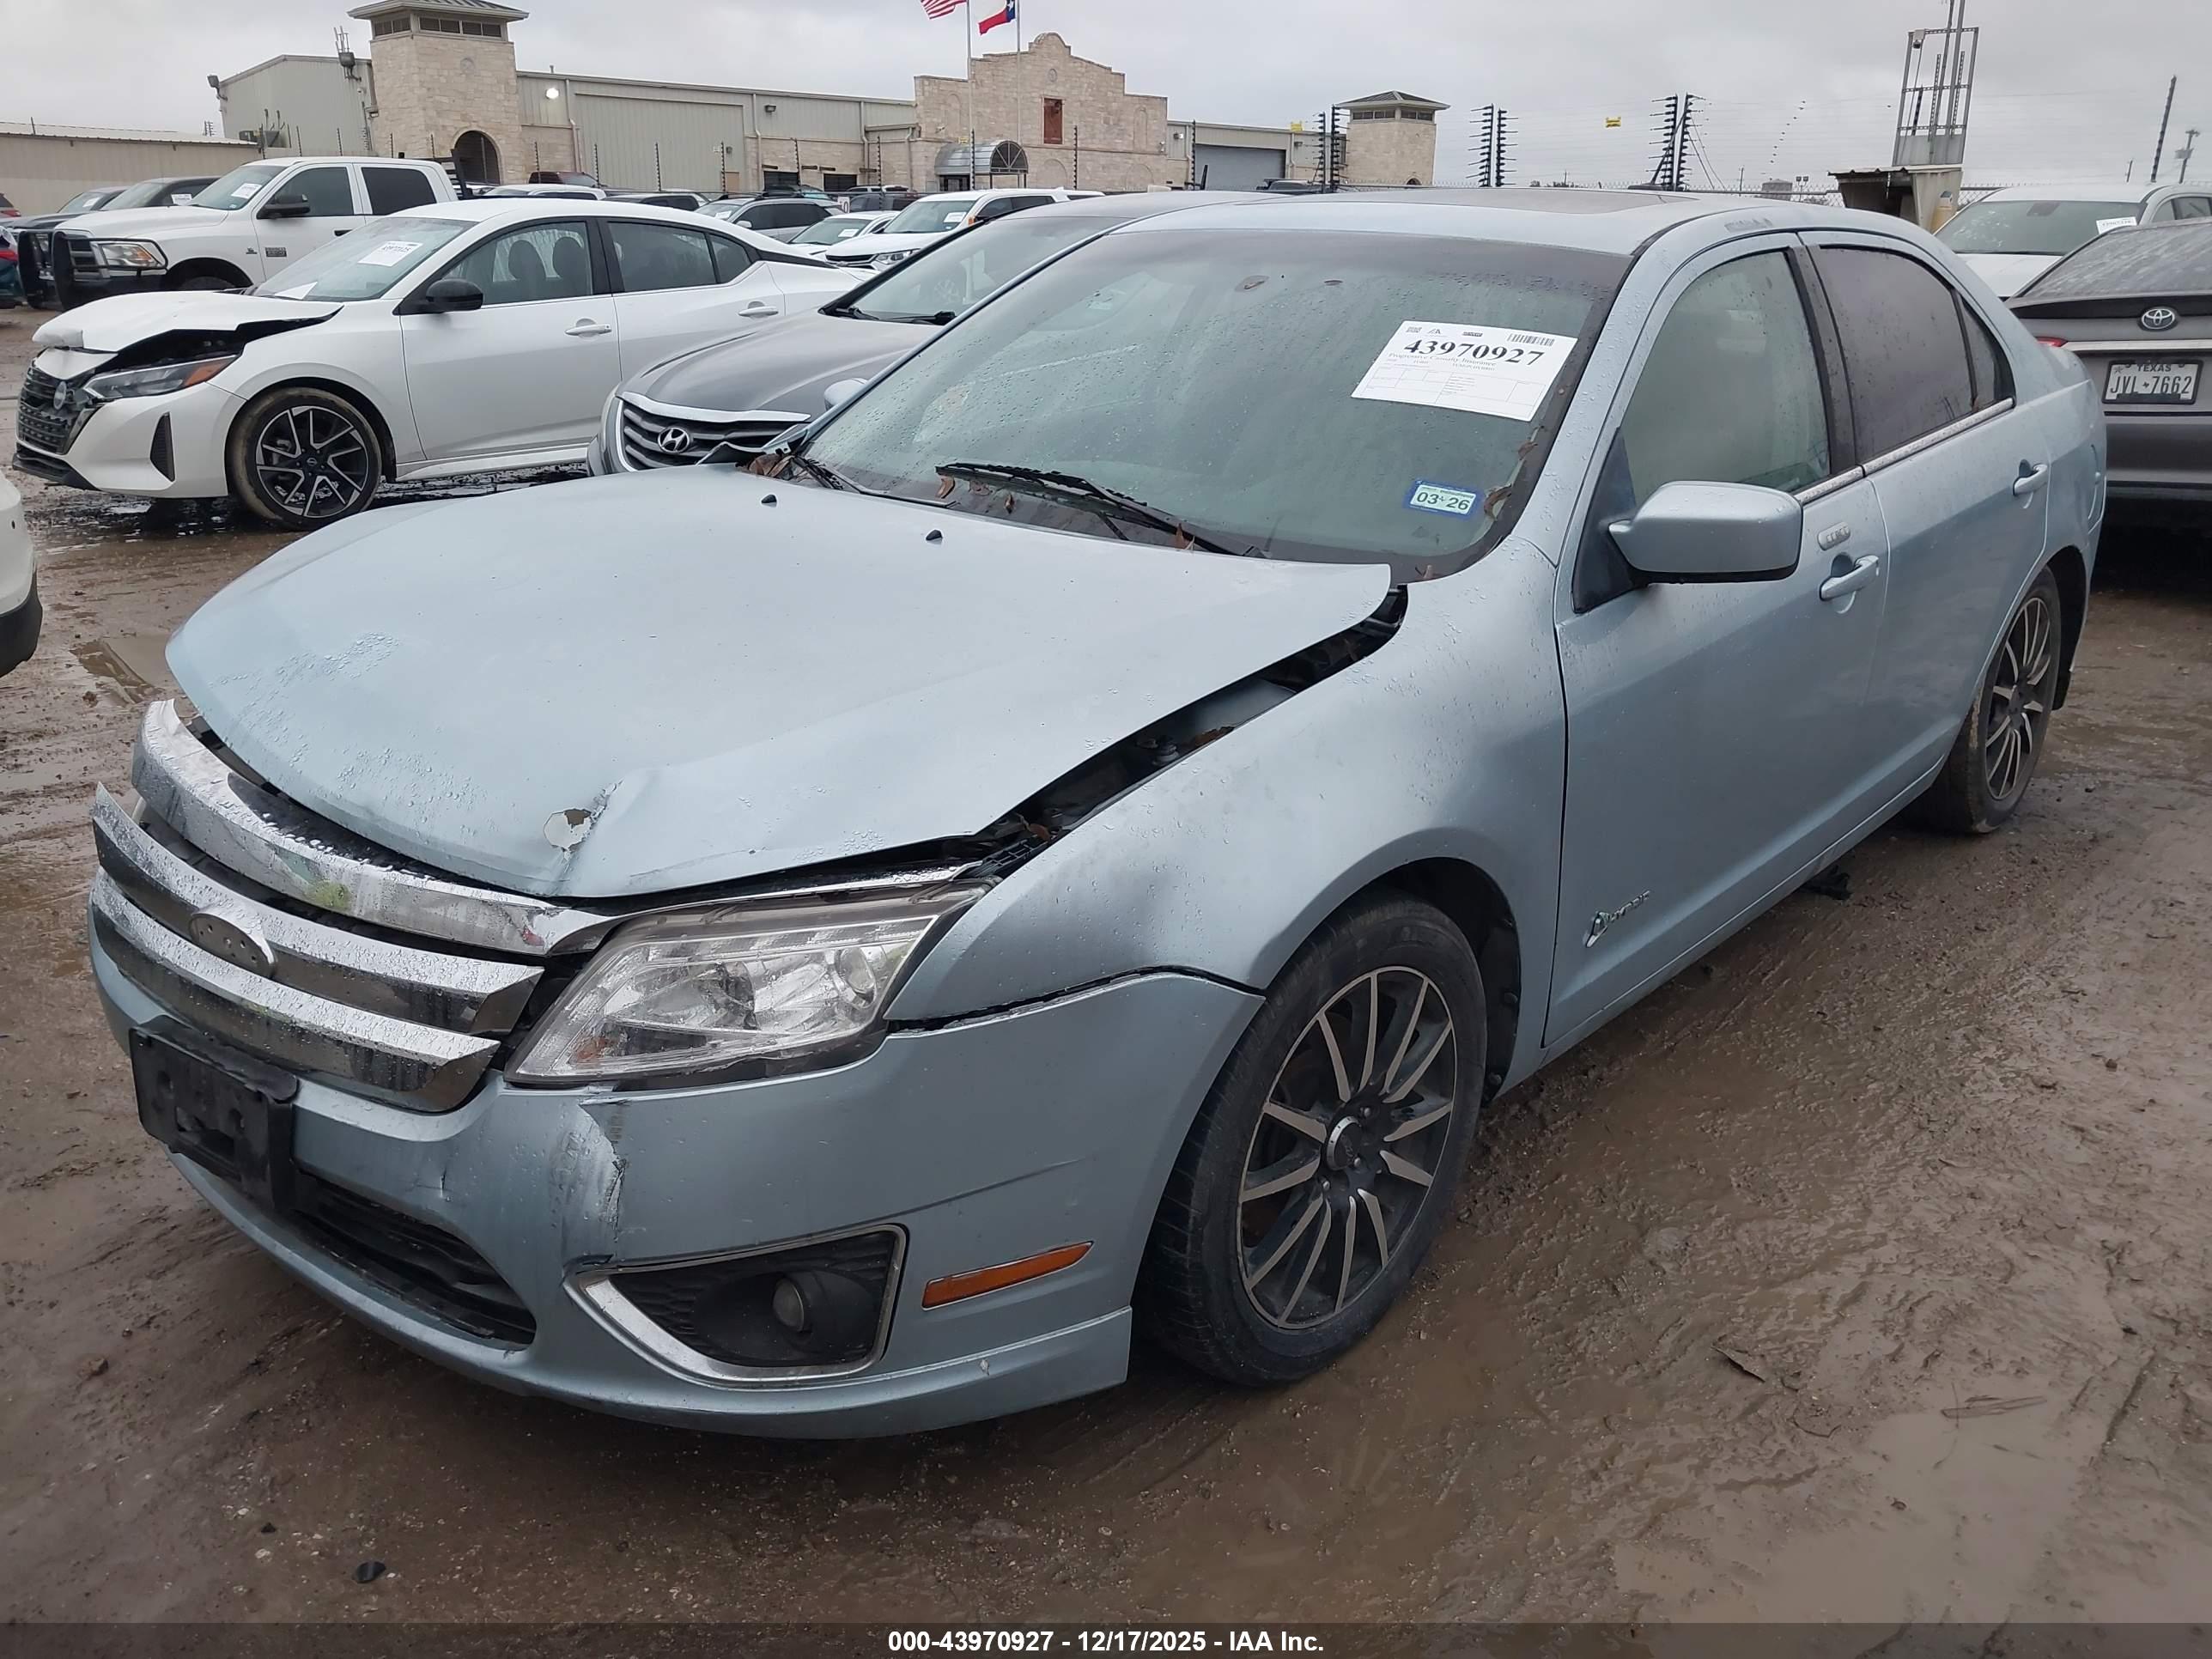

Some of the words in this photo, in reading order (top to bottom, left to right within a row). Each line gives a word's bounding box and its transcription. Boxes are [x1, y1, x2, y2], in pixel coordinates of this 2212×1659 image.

[1404, 339, 1545, 366] 43970927
[2137, 363, 2172, 372] TEXAS
[2110, 375, 2138, 394] JVL
[2150, 375, 2192, 394] 7662
[1417, 492, 1439, 505] 03
[1446, 497, 1470, 510] 26
